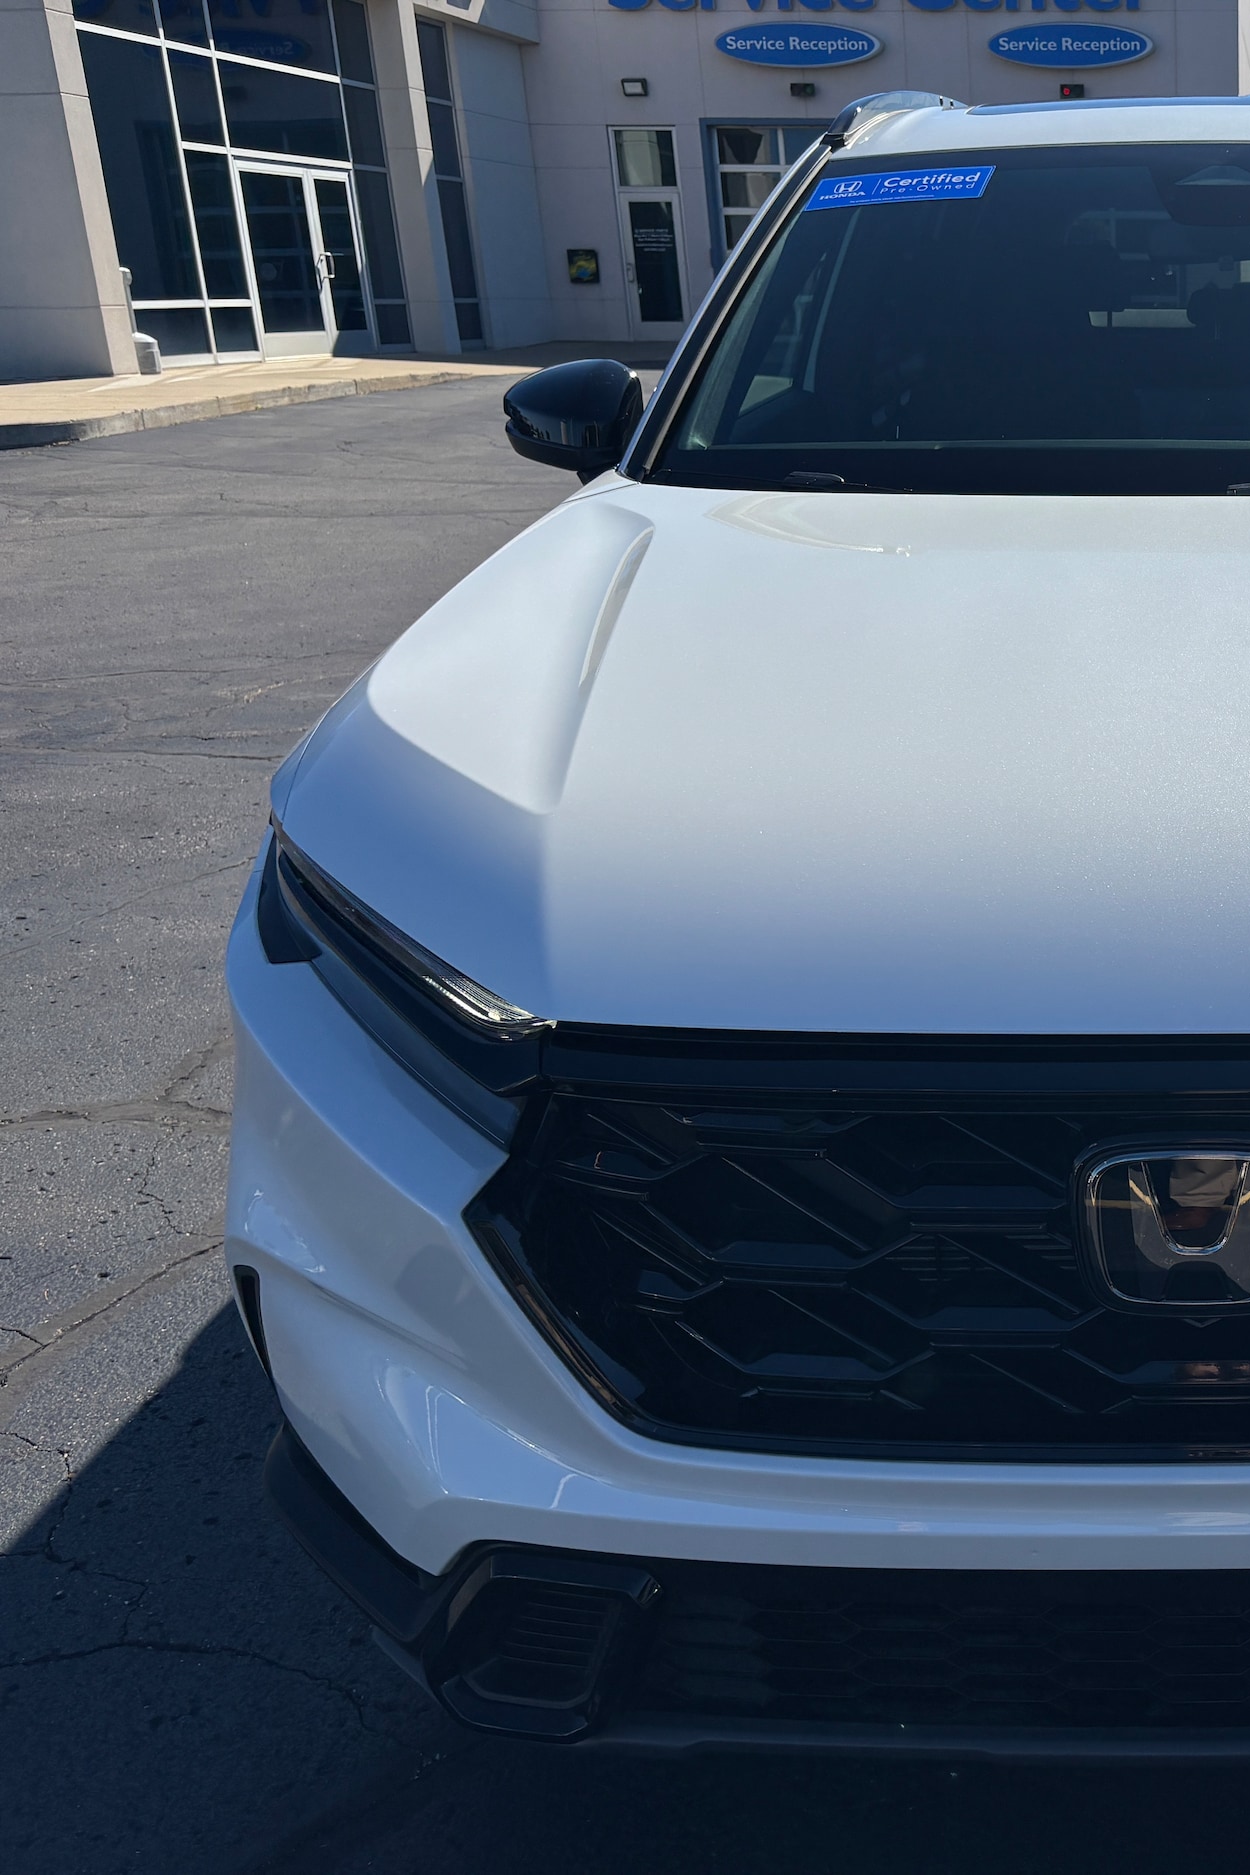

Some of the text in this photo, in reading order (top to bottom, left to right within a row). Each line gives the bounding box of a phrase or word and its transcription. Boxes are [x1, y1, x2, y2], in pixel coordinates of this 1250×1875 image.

[725, 36, 869, 54] Service Reception
[998, 37, 1141, 55] Service Reception
[883, 171, 982, 187] Certified
[819, 191, 866, 200] HONDA
